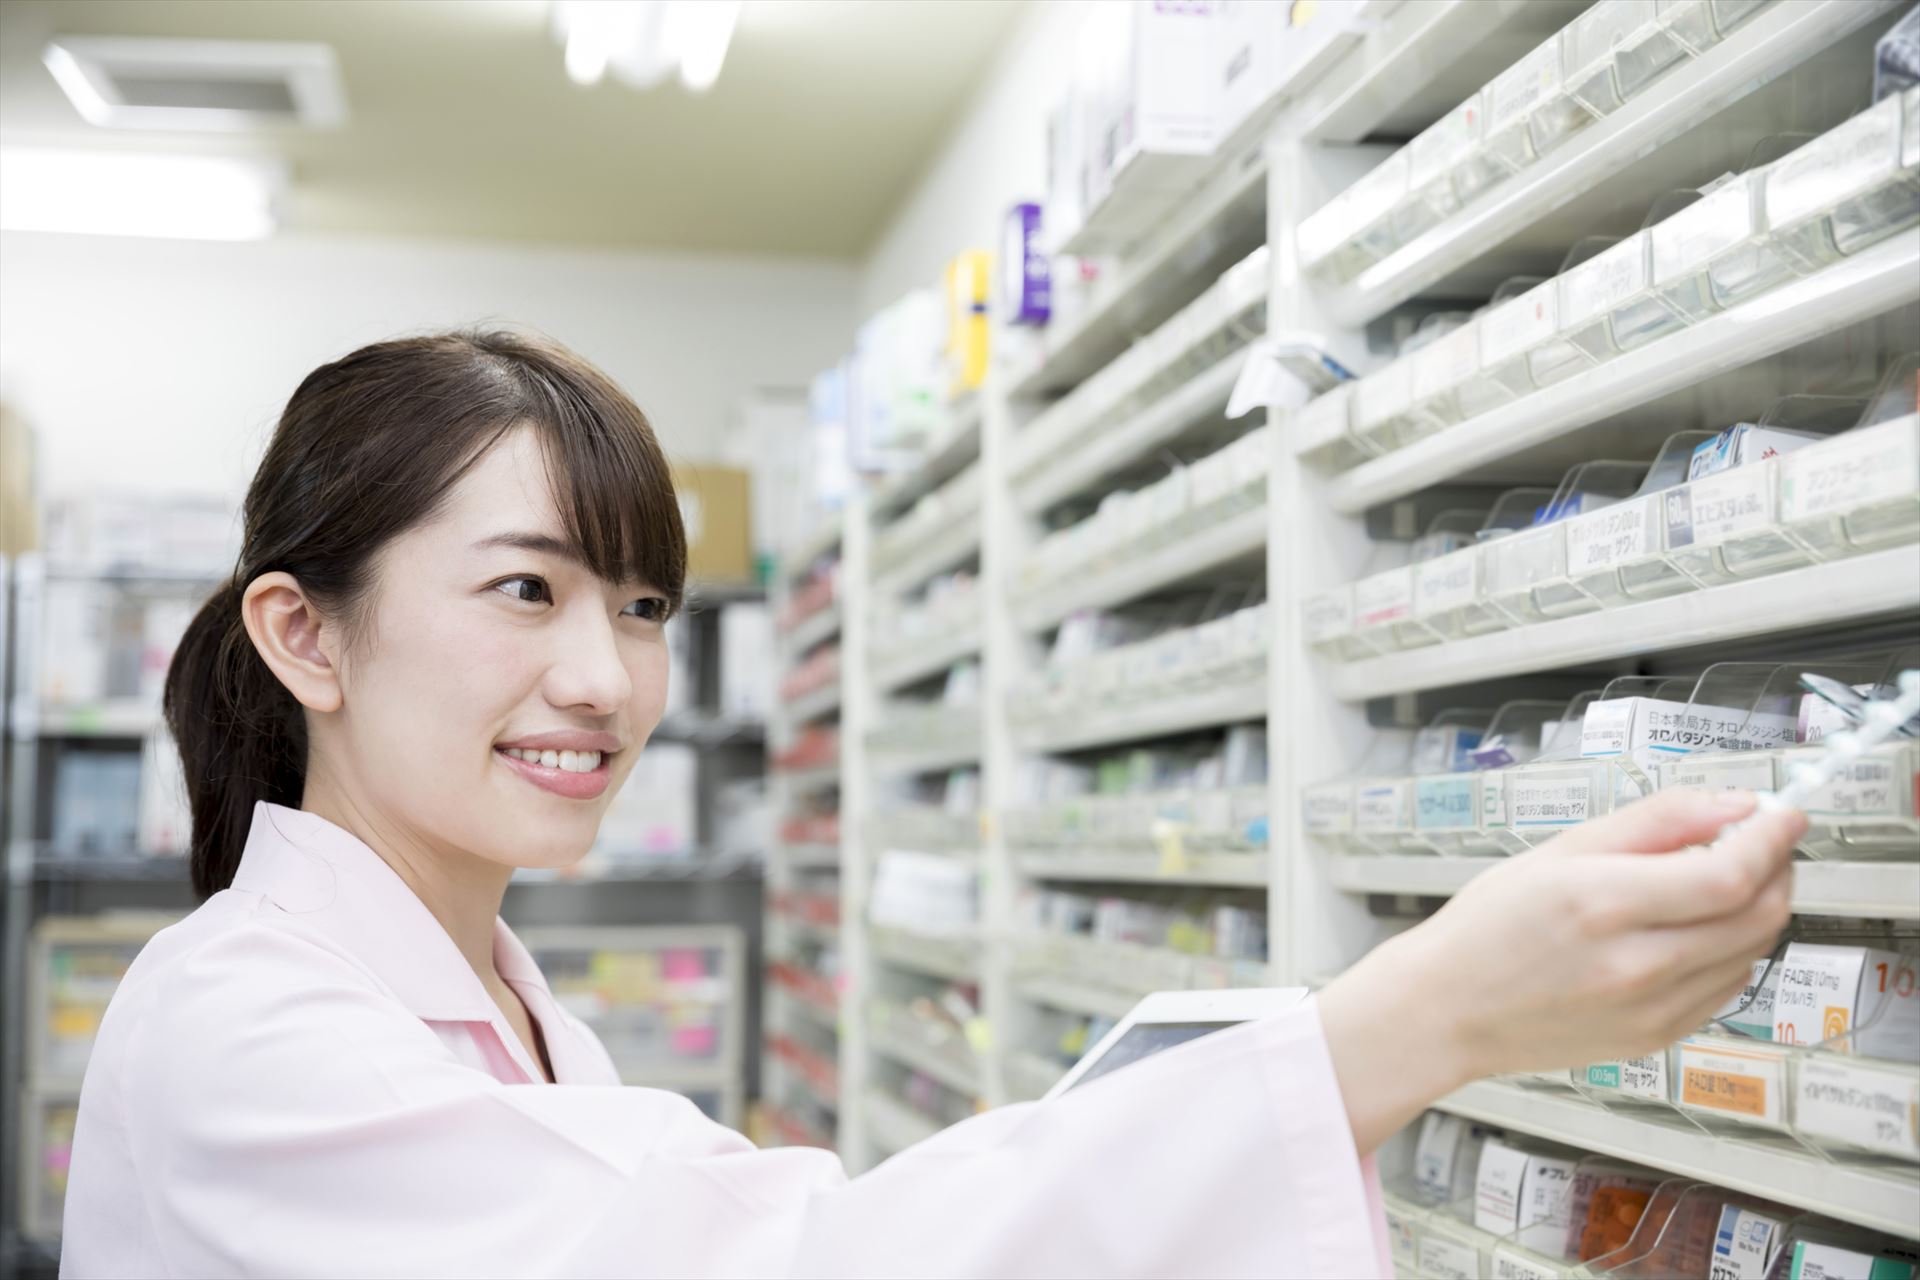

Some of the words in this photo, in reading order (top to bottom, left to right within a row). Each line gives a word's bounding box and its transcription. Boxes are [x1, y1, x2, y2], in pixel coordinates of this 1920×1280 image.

[1650, 711, 1712, 733] 日本薬局方
[1782, 968, 1840, 990] FAD錠10mg
[1641, 1072, 1658, 1089] サワイ
